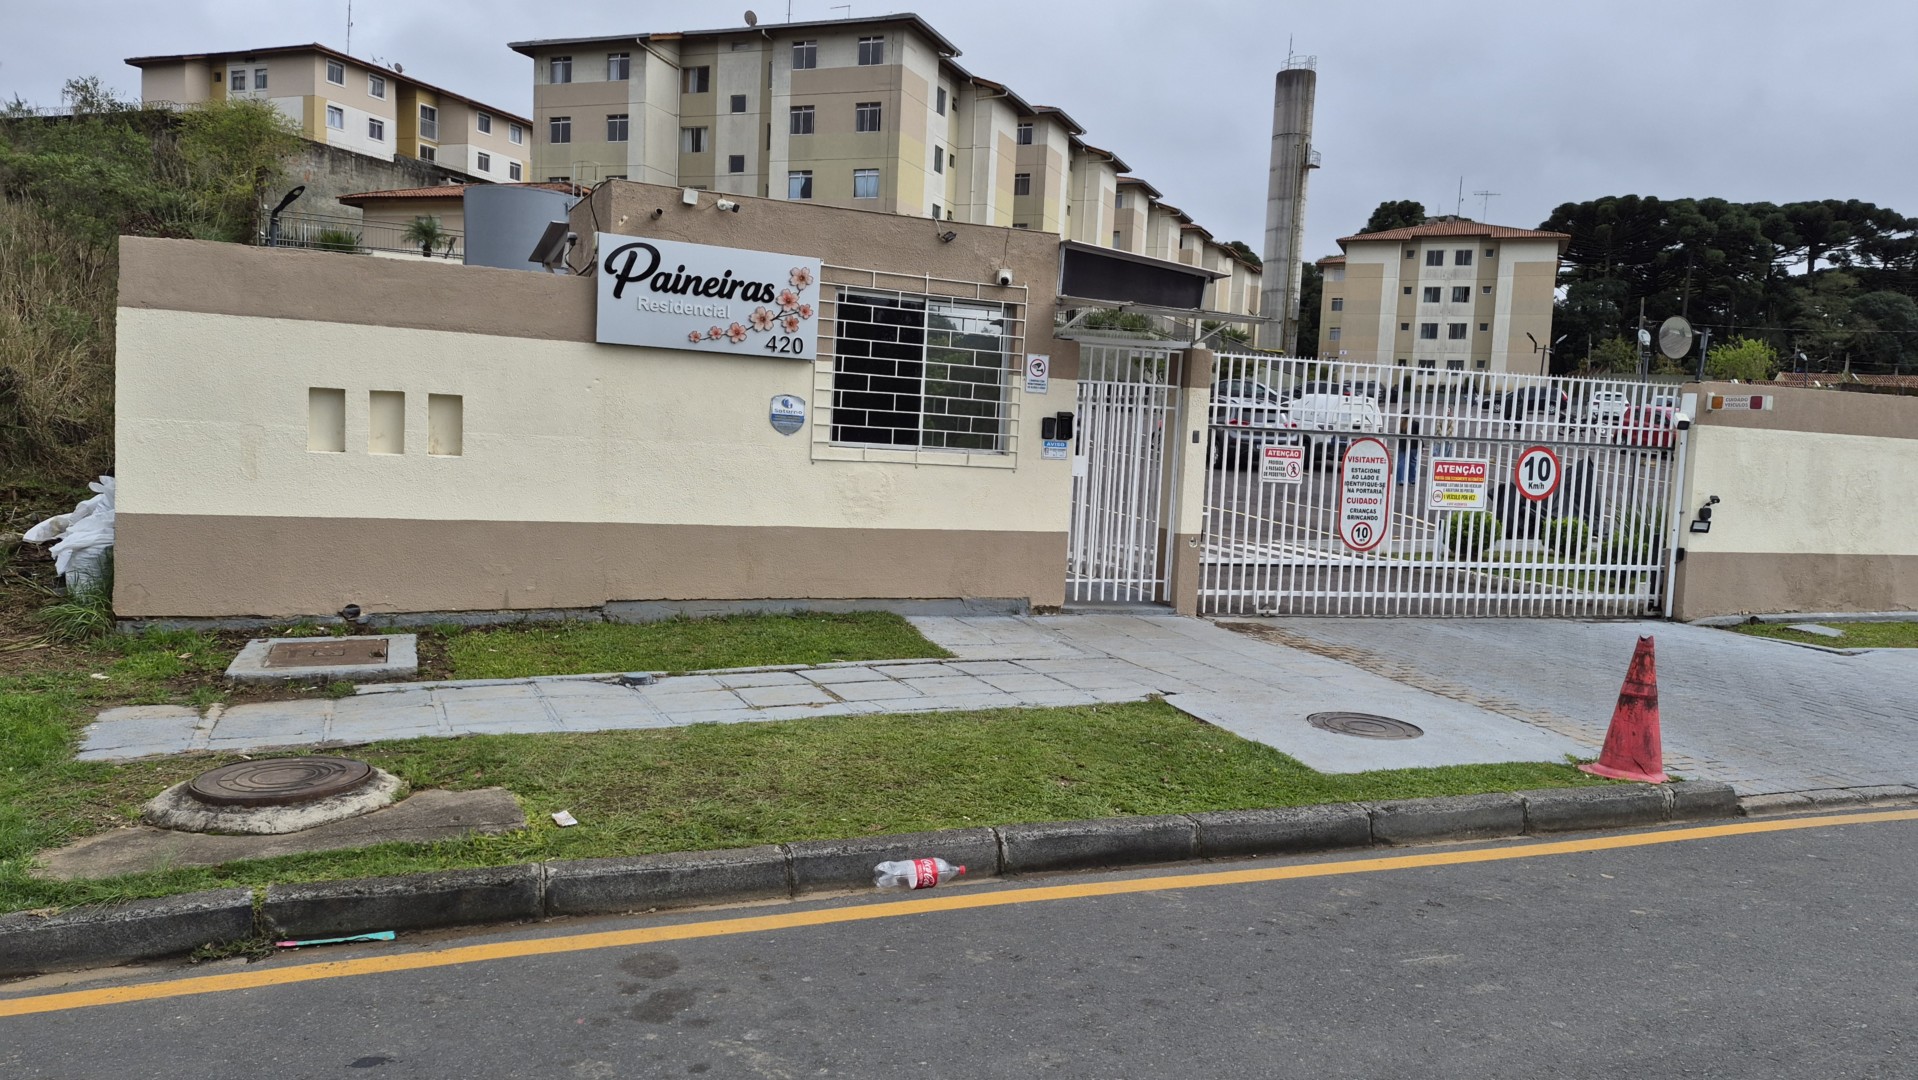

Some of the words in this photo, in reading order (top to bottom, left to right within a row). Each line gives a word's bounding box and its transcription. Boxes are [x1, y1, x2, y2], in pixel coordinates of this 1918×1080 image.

[604, 242, 775, 303] Paineiras
[637, 295, 730, 319] Residencial
[765, 335, 804, 354] 420
[1267, 449, 1299, 458] ATENÇÃO
[1347, 456, 1387, 464] VISITANTE:
[1436, 464, 1484, 476] ATENÇÃO
[1524, 456, 1551, 481] 10
[1346, 497, 1378, 505] CUIDADO
[1355, 527, 1369, 539] 10
